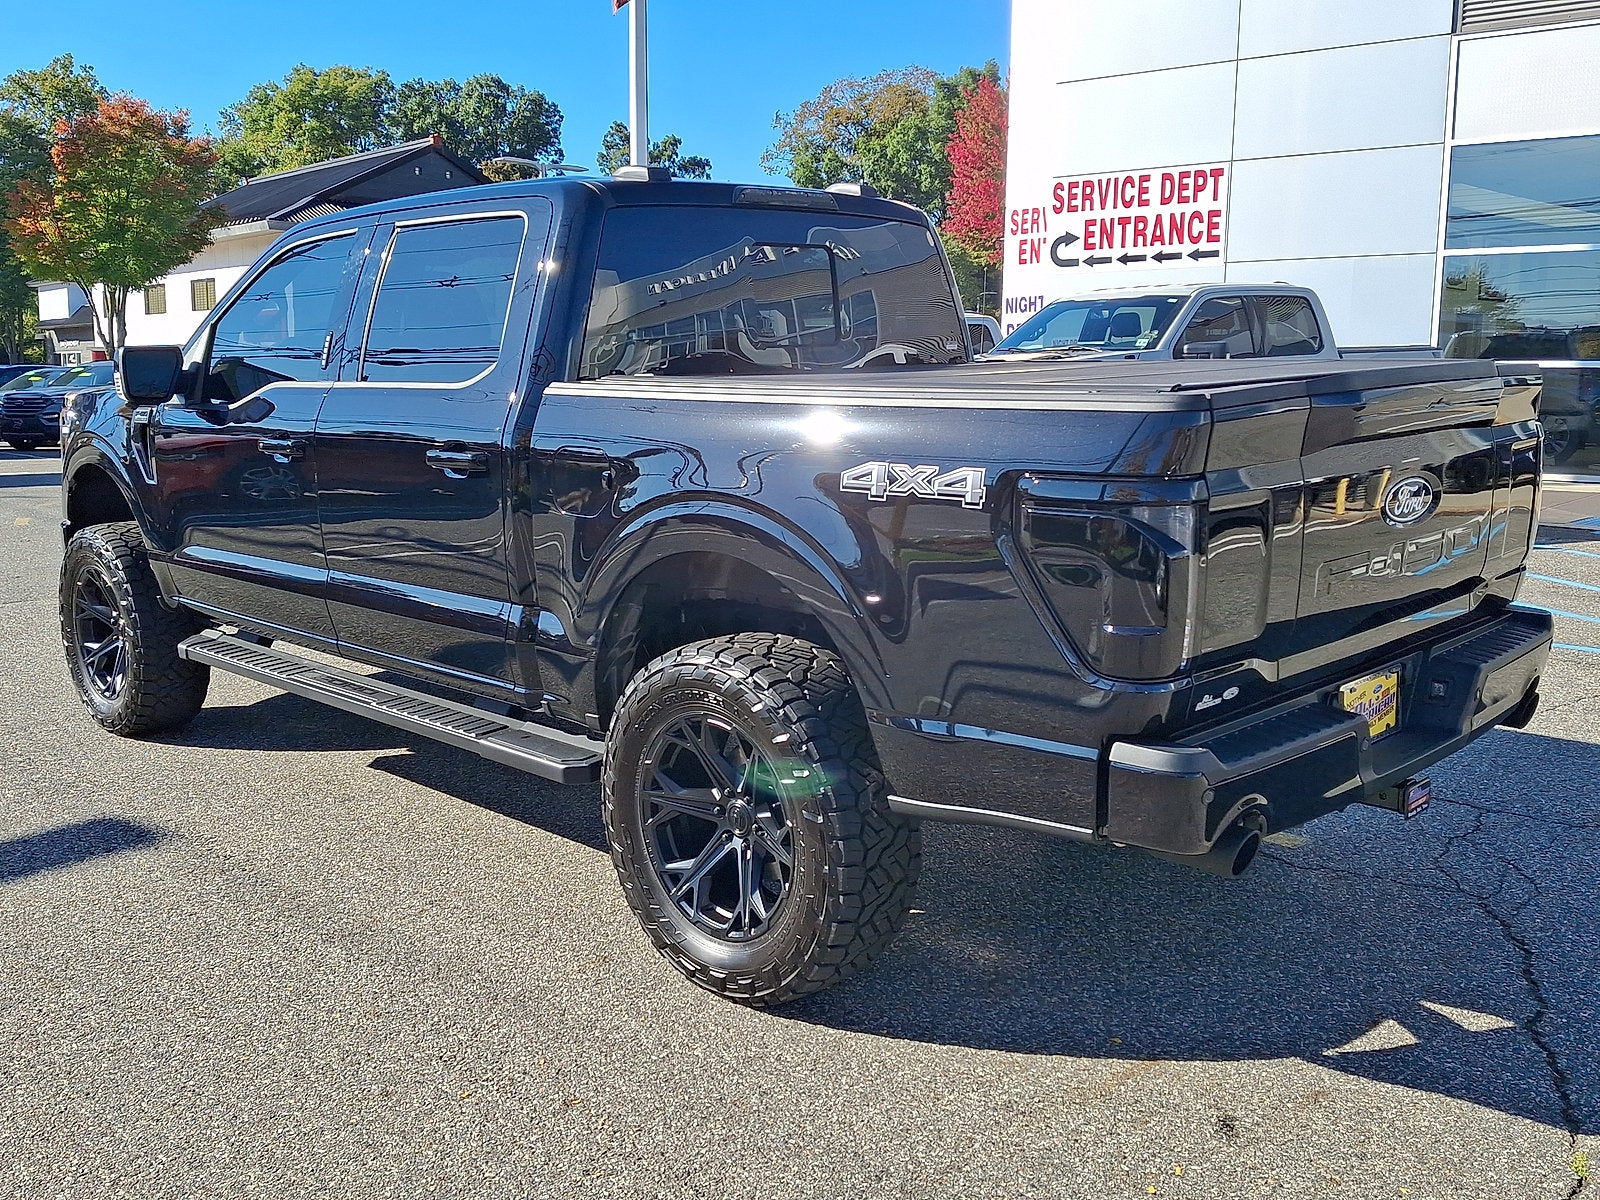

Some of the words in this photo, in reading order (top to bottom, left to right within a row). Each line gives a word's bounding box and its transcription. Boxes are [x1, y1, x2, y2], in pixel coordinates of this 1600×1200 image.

[1052, 174, 1151, 215] SERVICE
[1160, 167, 1225, 206] DEPT
[1083, 209, 1222, 251] ENTRANCE
[1018, 237, 1047, 266] EN
[1005, 295, 1044, 314] NIGHT
[1394, 485, 1425, 516] Ford
